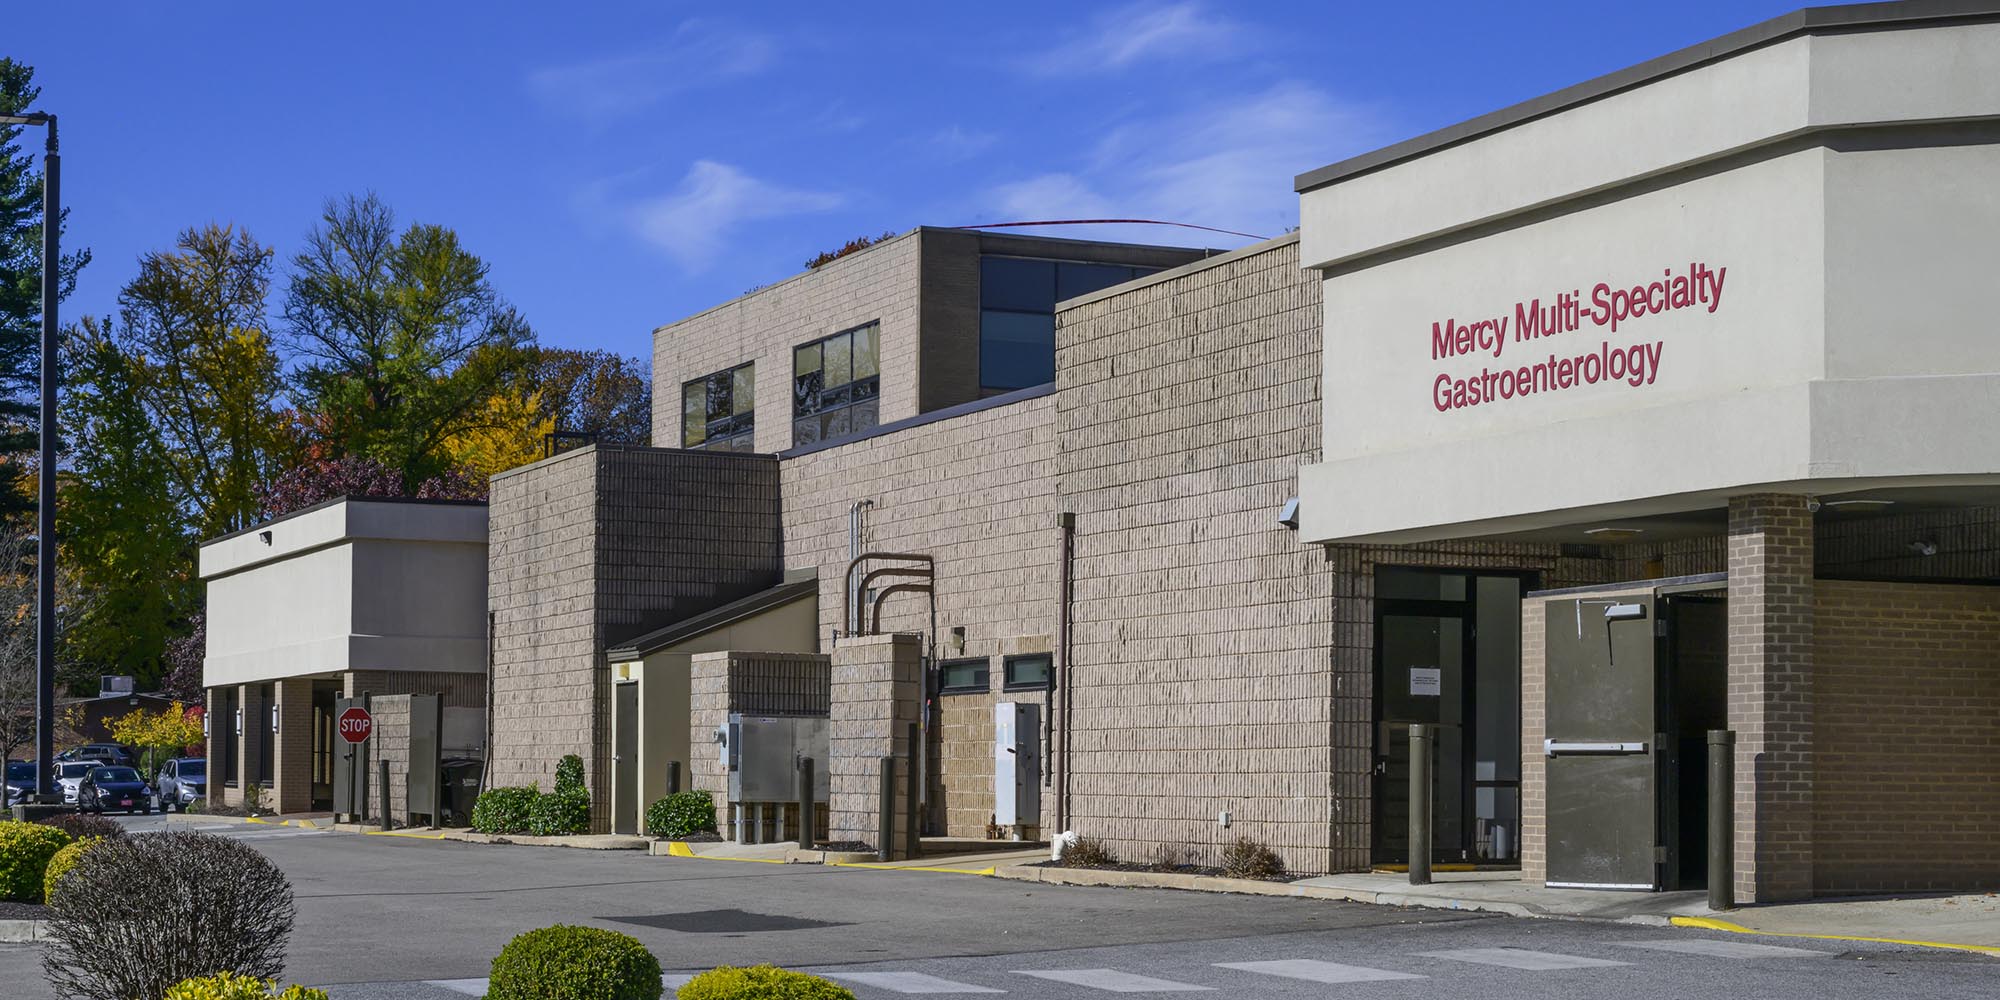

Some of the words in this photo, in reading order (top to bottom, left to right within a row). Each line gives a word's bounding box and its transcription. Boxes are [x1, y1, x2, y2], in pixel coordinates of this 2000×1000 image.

[1431, 316, 1508, 360] Mercy
[1515, 263, 1727, 342] Multi-Specialty
[1433, 341, 1663, 412] Gastroenterology
[341, 718, 370, 732] STOP
